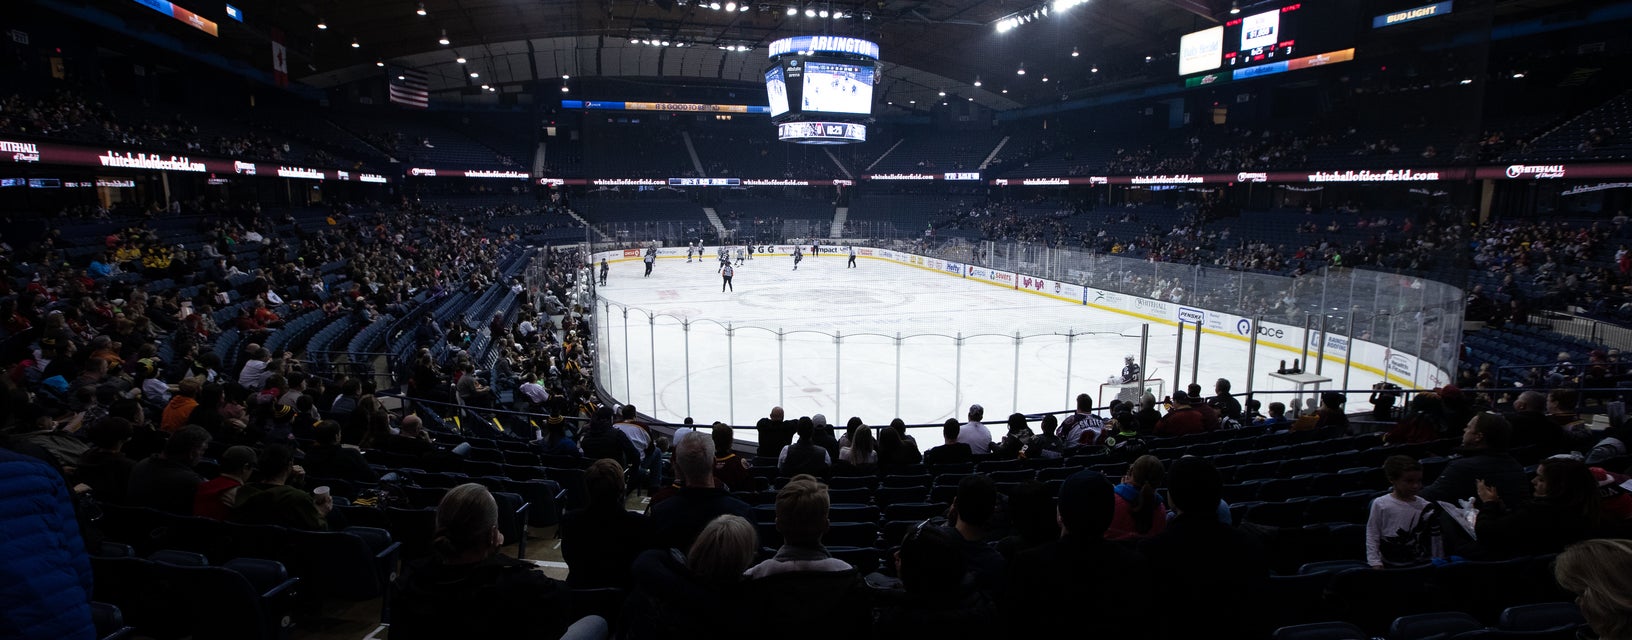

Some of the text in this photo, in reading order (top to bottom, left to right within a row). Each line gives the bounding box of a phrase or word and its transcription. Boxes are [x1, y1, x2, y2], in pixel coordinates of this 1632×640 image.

[1386, 5, 1437, 24] BUD LIGHT
[809, 36, 872, 56] ARLINGTON
[99, 150, 206, 172] whitehallofdeerfield.com
[464, 169, 529, 179] whitehallofdeerfield.com
[1308, 169, 1439, 182] whitehallofdeerfield.com
[1506, 165, 1565, 178] WHITEHALL
[593, 178, 666, 186] whitehallofdeerfield.com
[1131, 174, 1203, 184] whitehallofdeerfield.com
[817, 245, 837, 254] mpact
[947, 263, 960, 274] Hefty
[995, 272, 1011, 282] savers
[1180, 310, 1202, 320] PENSKE
[1258, 326, 1284, 339] ace
